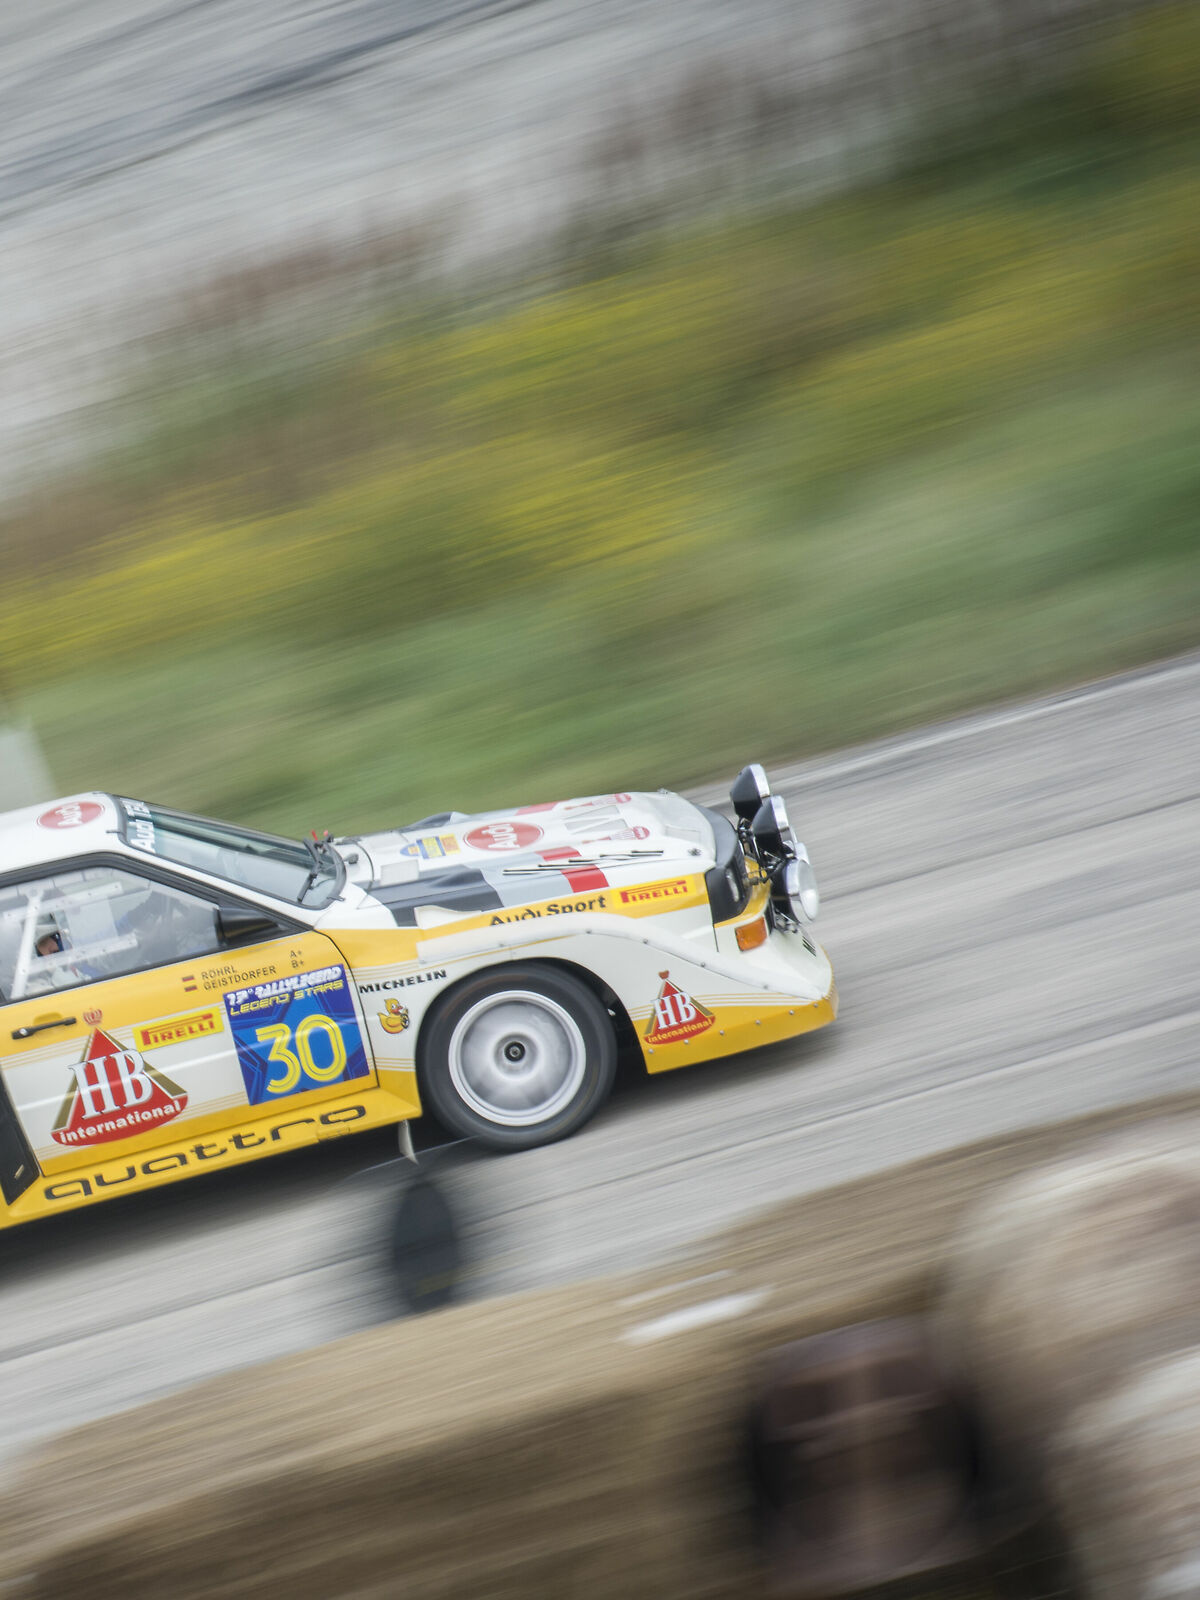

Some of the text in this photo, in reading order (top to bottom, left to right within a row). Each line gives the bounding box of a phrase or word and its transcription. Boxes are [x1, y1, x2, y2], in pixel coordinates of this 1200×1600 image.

[482, 823, 520, 848] Audi
[620, 880, 688, 904] PIRELLI
[203, 965, 277, 991] GEISTDORFER
[359, 969, 447, 994] MICHELIN
[230, 979, 344, 1016] LEGEND STARS
[650, 991, 696, 1030] HB
[141, 1013, 215, 1046] PIRELLI
[648, 1016, 712, 1043] international
[255, 1014, 347, 1094] 30
[68, 1048, 153, 1120] HB
[59, 1097, 182, 1144] international
[44, 1105, 366, 1201] quattro
